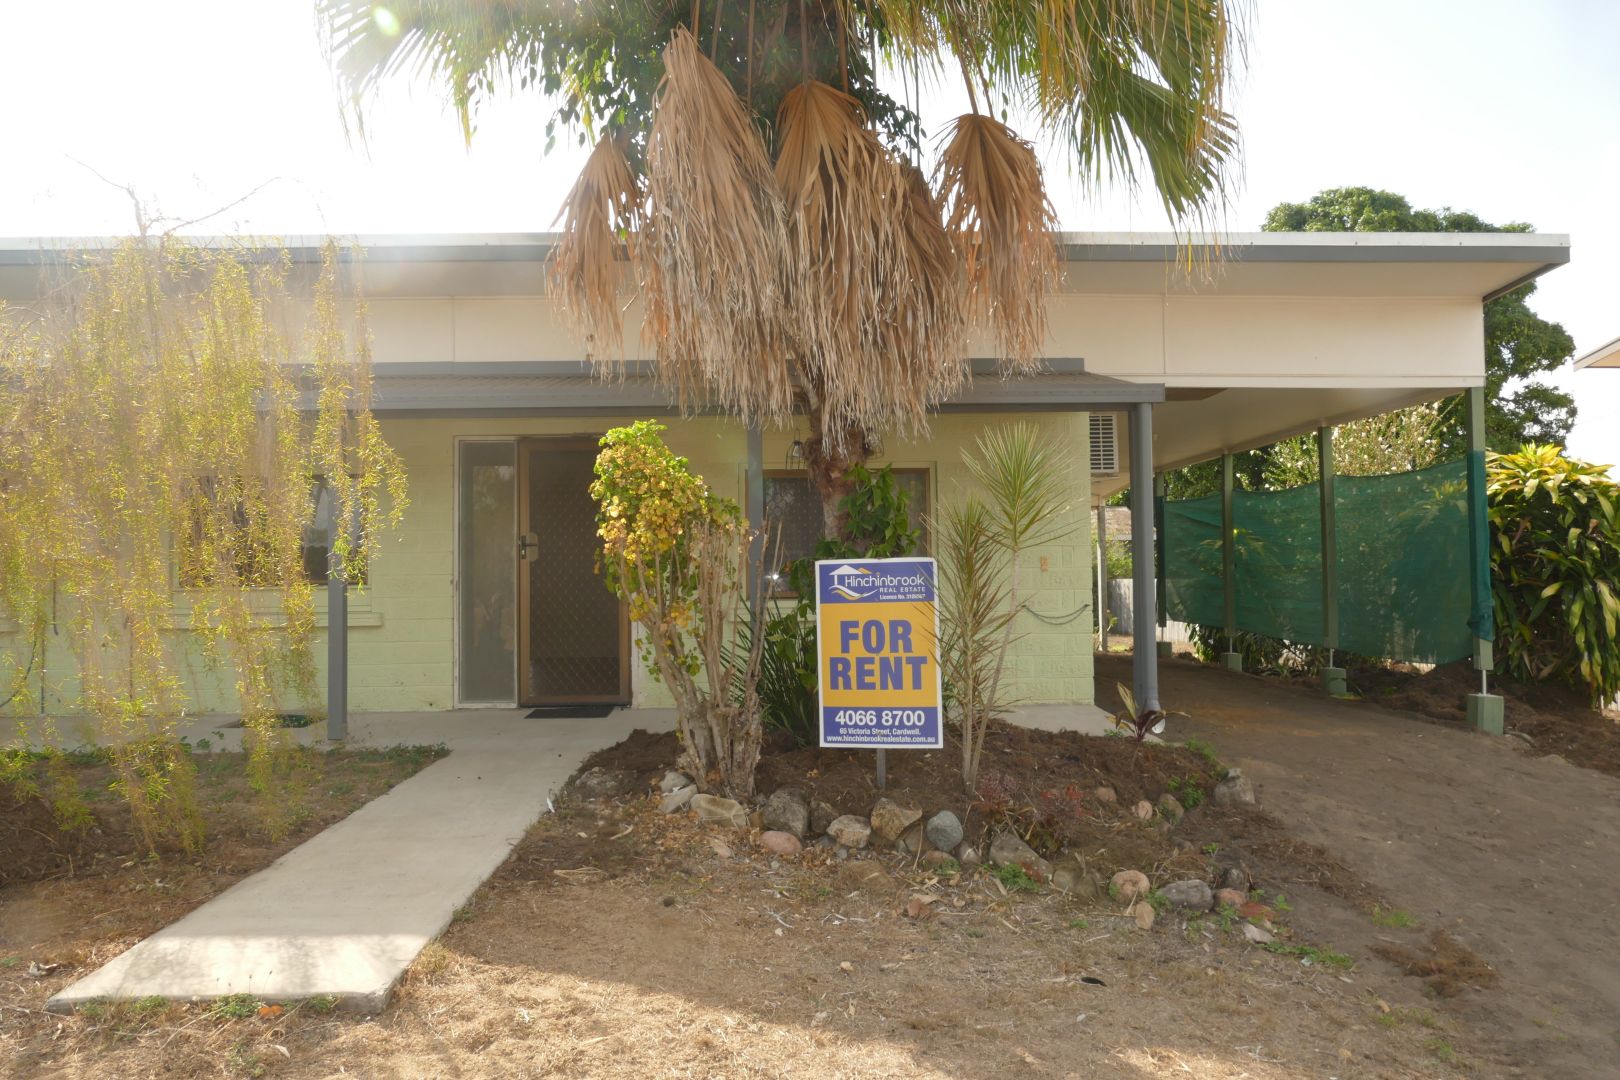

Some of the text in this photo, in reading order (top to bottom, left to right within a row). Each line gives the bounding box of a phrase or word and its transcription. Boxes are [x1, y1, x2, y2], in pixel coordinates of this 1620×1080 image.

[845, 572, 925, 588] Hinchinbrook
[840, 619, 913, 654] FOR
[829, 656, 927, 690] RENT
[835, 710, 925, 726] 4066 8700
[826, 735, 936, 744] www.hinchinbrookrealestate.com.au
[871, 728, 891, 736] Street,
